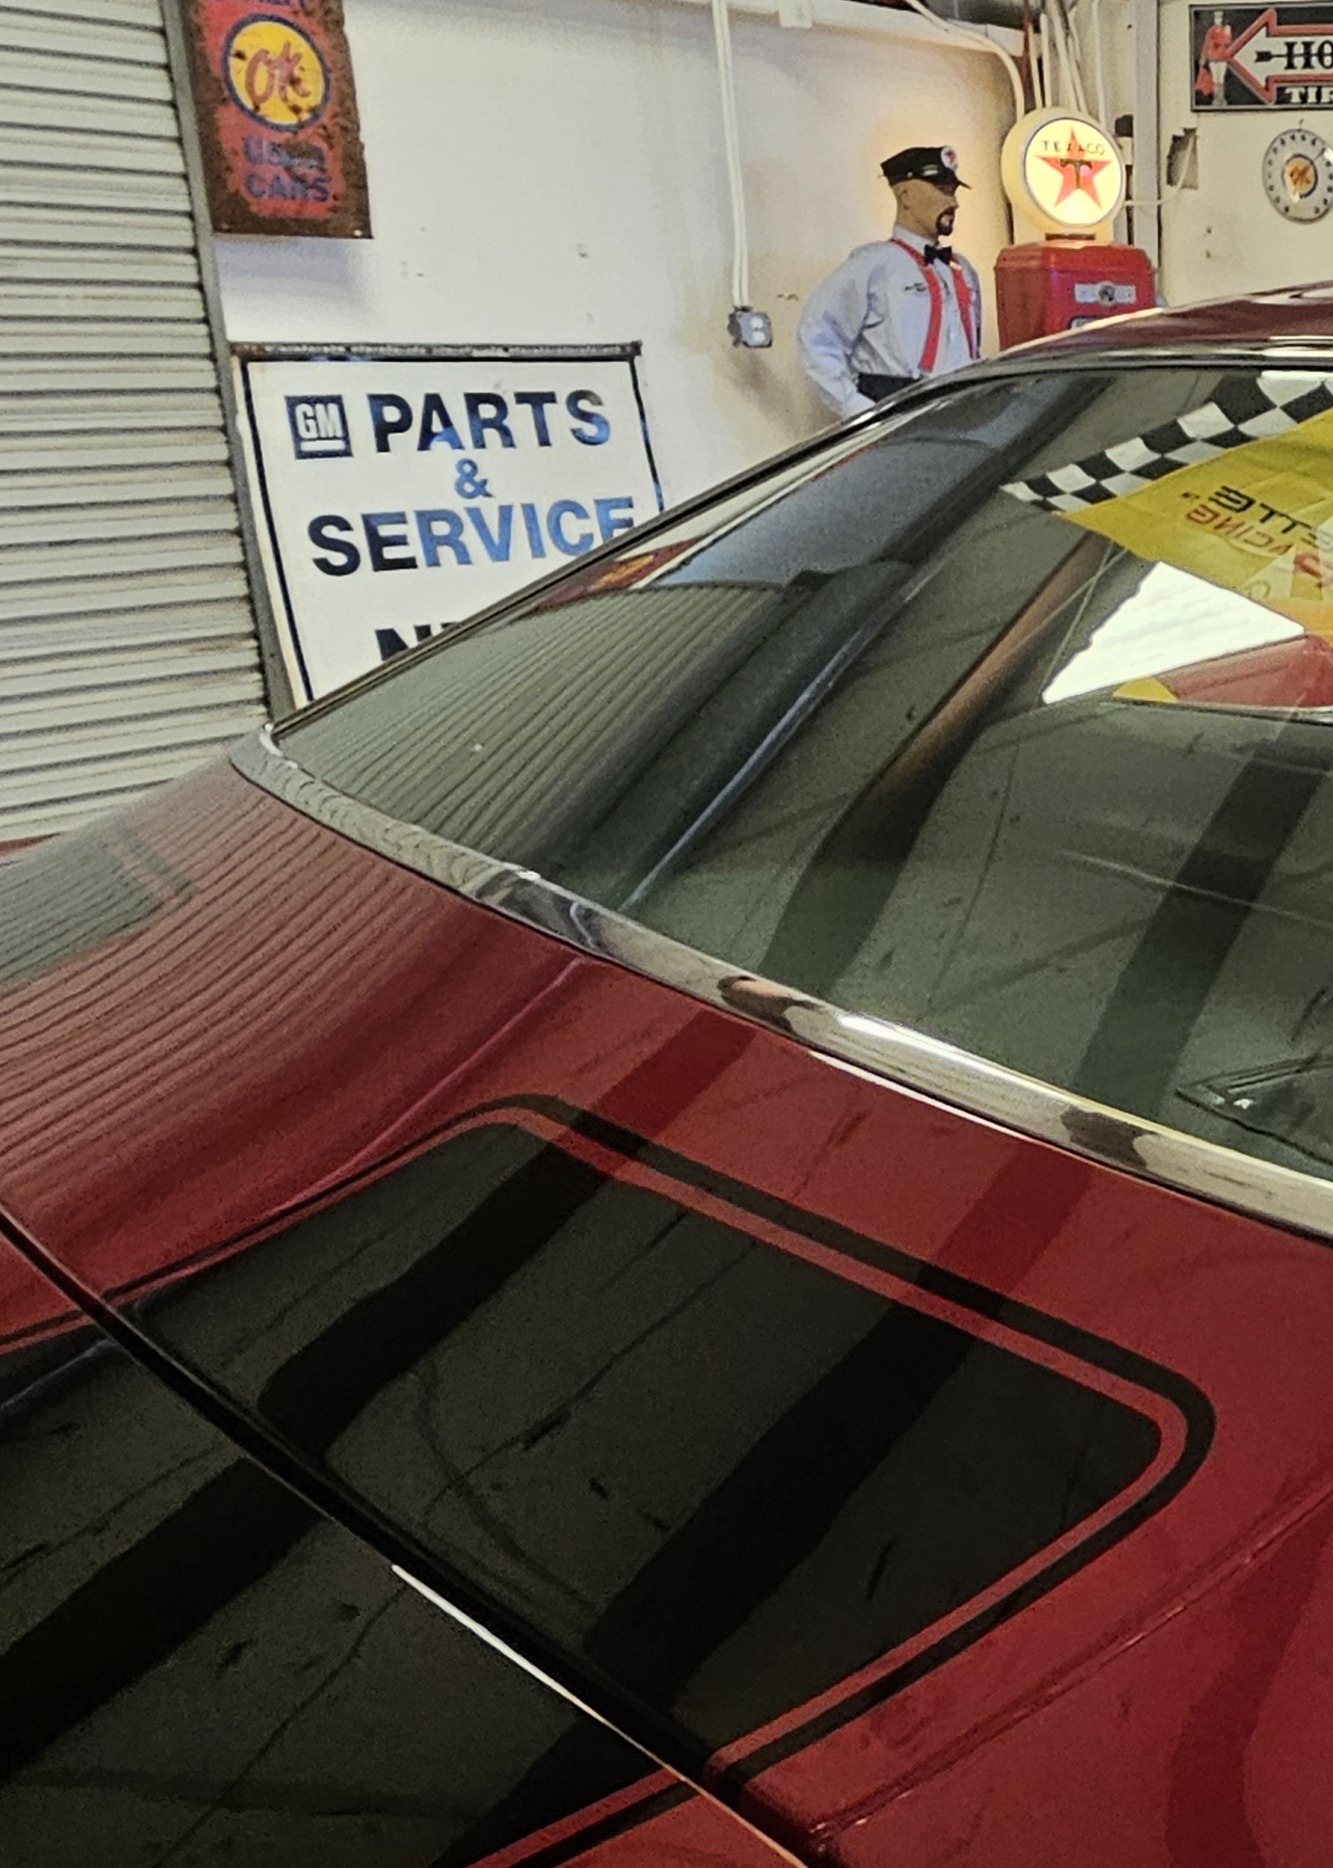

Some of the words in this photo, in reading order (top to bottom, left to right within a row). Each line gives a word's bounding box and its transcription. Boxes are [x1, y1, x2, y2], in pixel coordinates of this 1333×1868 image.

[1041, 140, 1105, 156] TEXACO
[367, 390, 611, 453] PARTS
[454, 458, 495, 500] &
